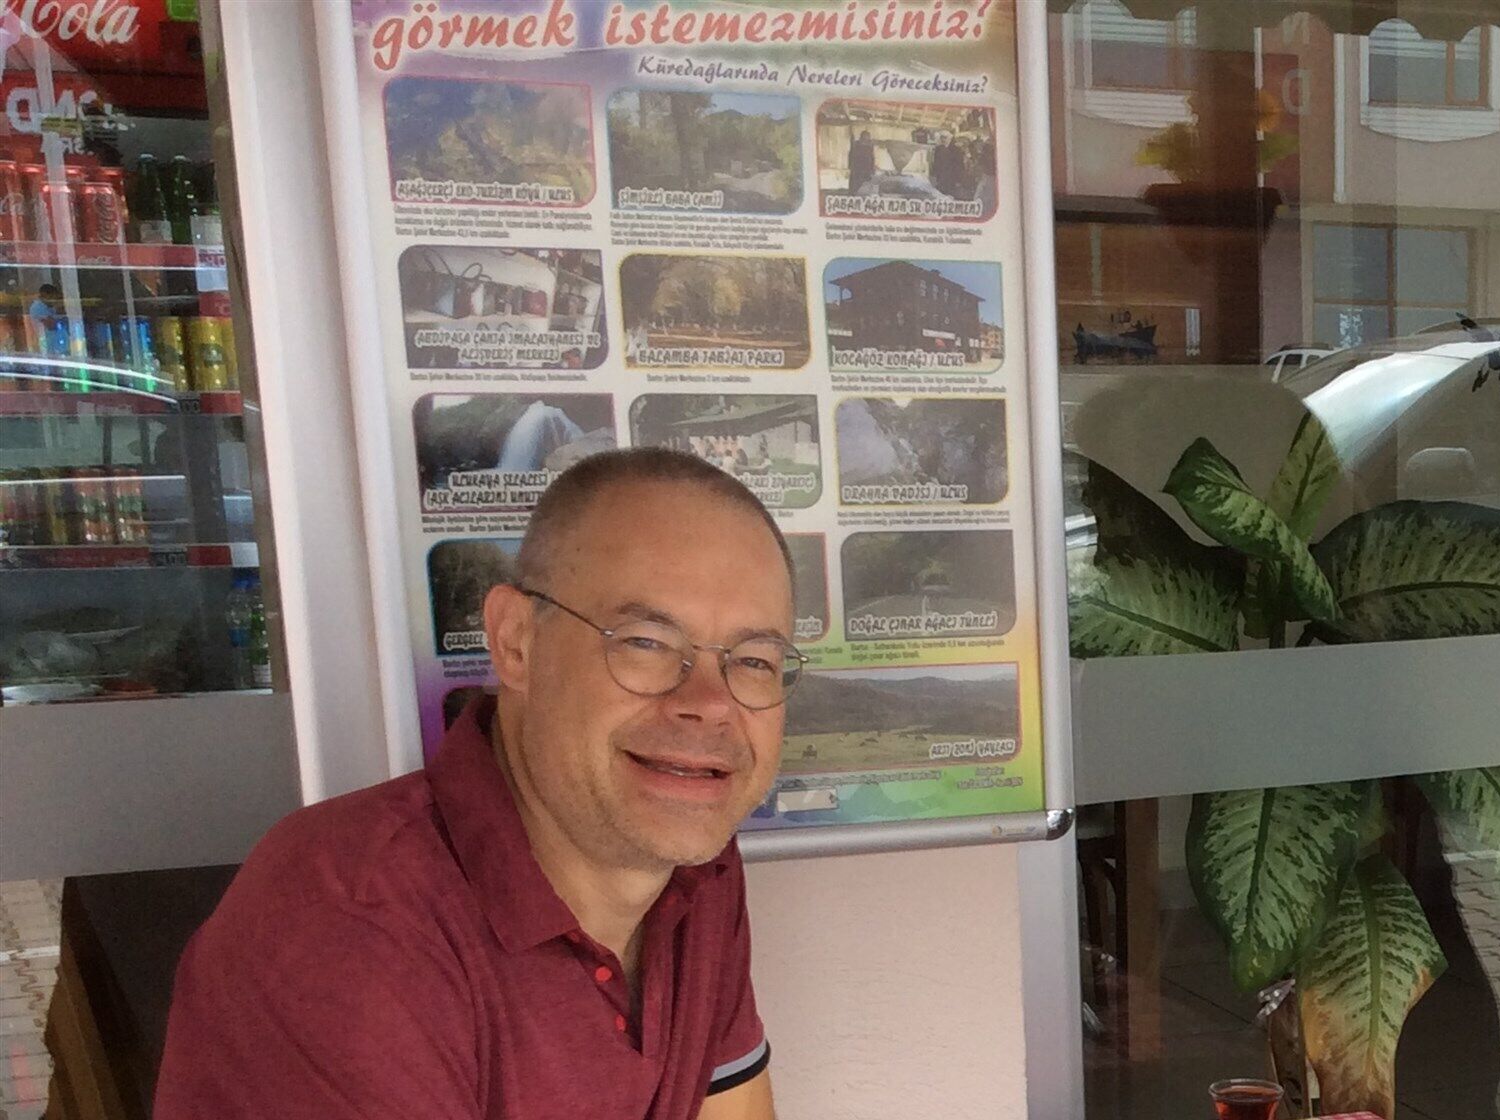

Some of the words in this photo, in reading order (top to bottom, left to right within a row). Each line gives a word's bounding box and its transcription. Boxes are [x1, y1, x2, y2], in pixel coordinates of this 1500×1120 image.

[372, 0, 575, 71] görmek
[605, 0, 992, 46] istemezmisiniz?
[638, 55, 779, 84] Küredağlarında
[786, 64, 863, 87] Nereleri
[871, 70, 989, 94] Göreceksiniz?
